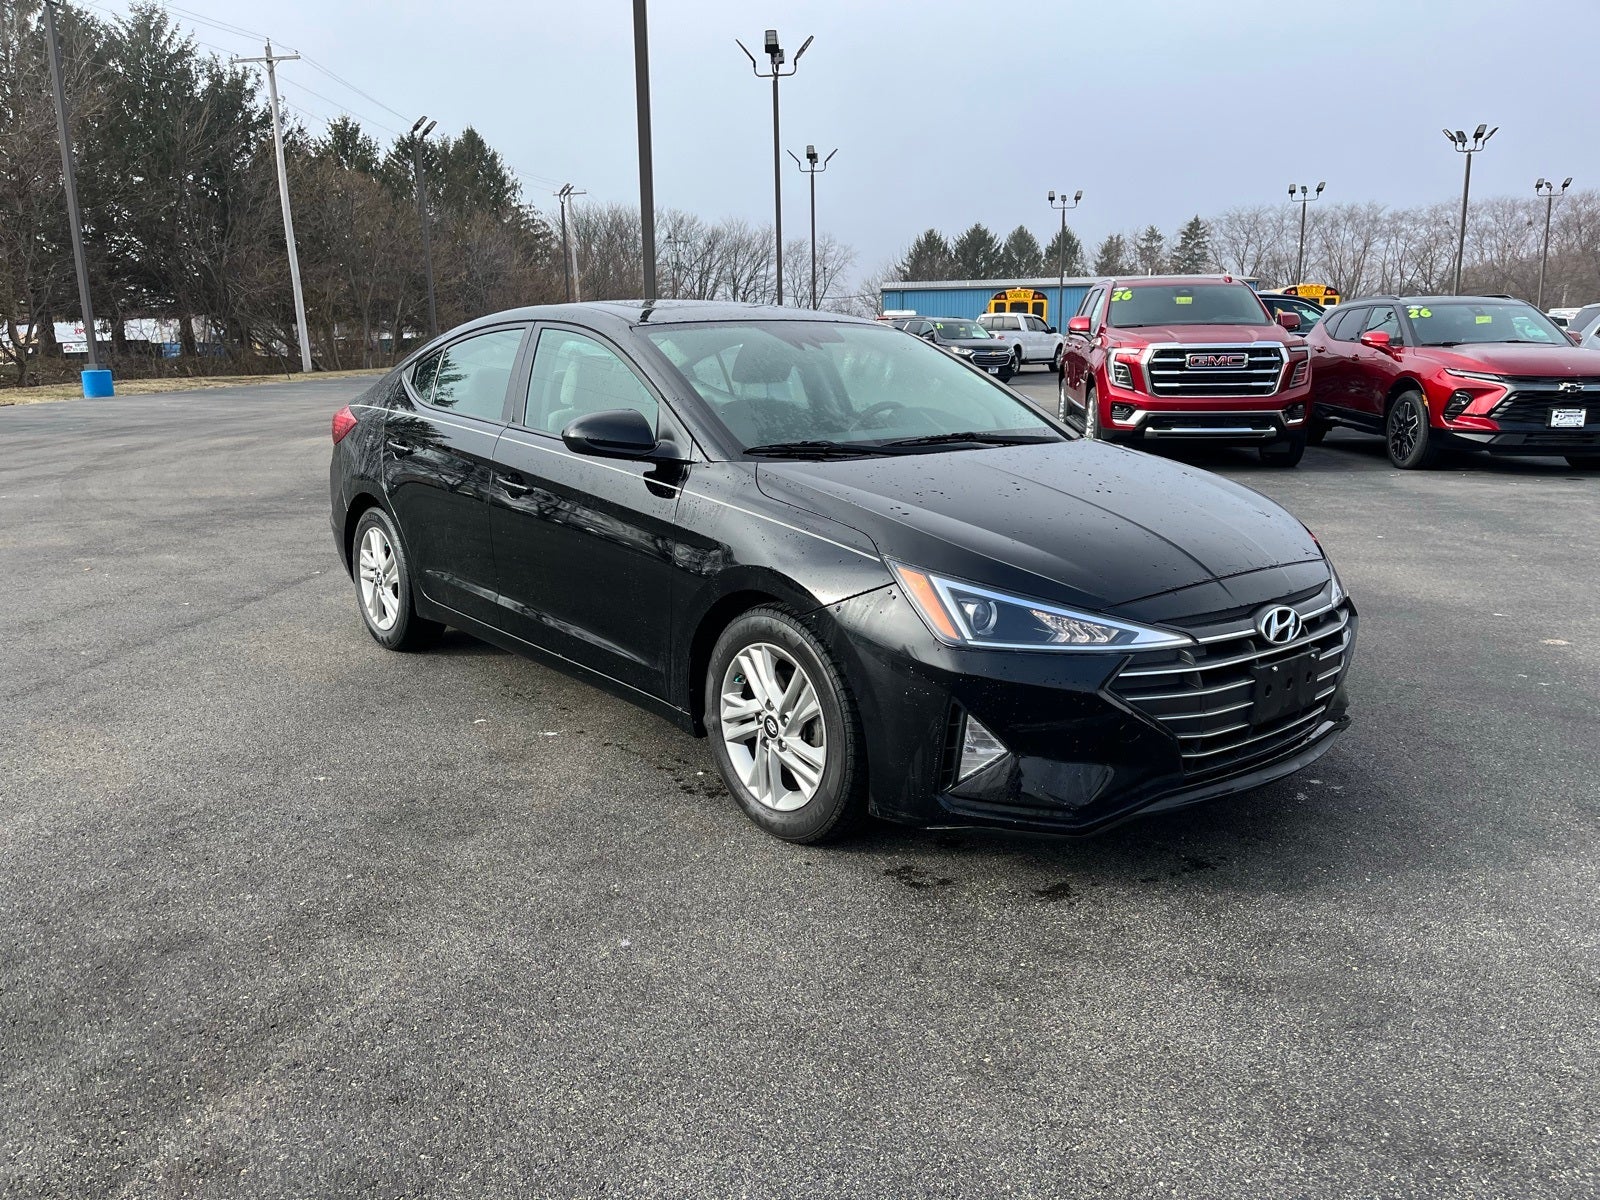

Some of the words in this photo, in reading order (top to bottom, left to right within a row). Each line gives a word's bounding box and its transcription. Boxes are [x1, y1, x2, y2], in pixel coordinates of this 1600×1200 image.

[1111, 290, 1132, 302] 26
[1408, 308, 1432, 318] 26
[1190, 354, 1246, 366] GMC
